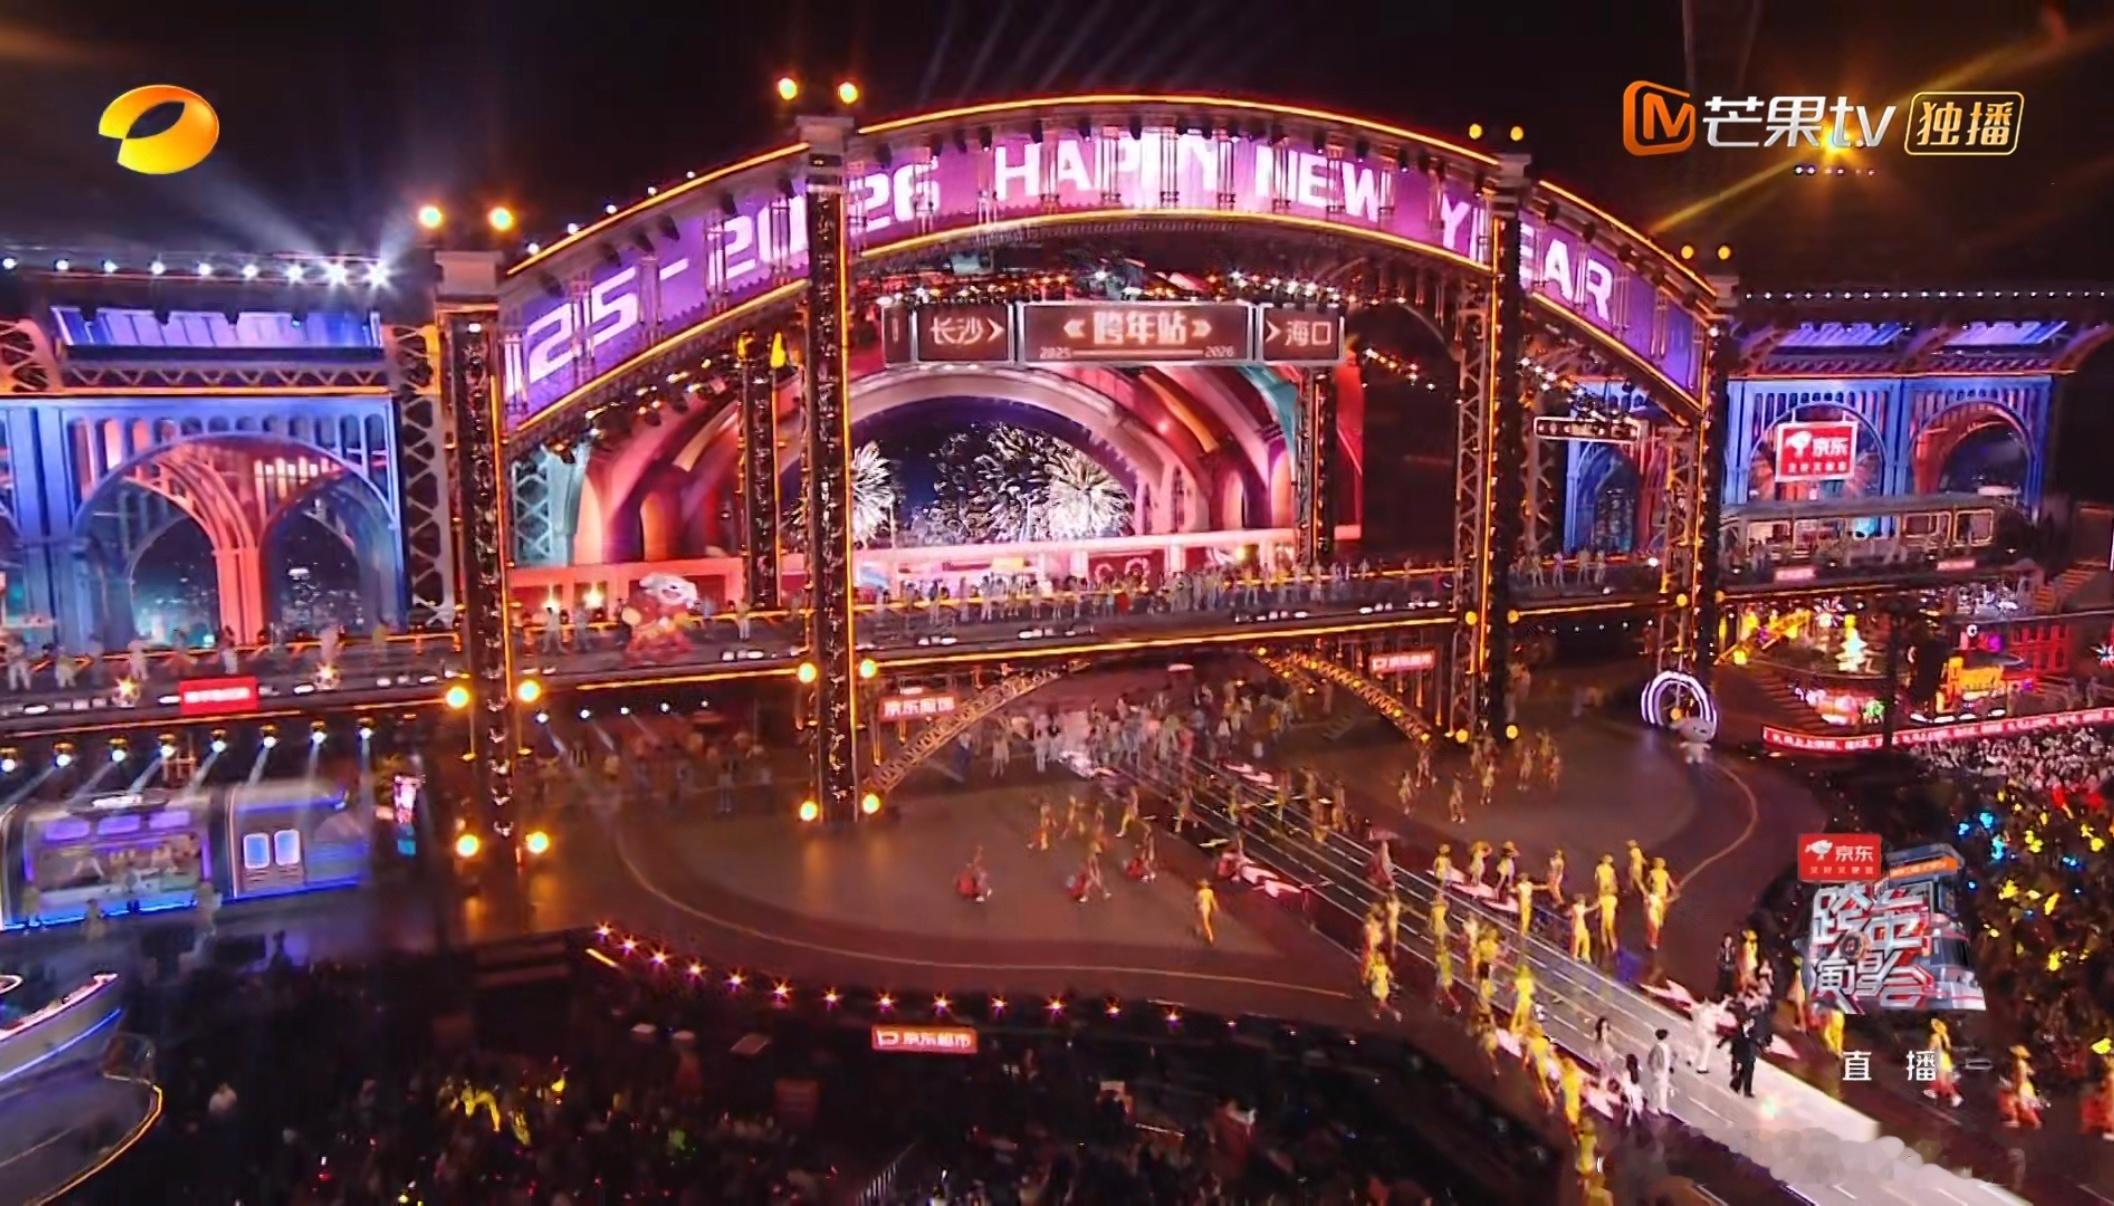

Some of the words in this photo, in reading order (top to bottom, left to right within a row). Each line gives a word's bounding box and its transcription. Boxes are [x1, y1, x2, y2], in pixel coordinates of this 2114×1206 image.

[930, 316, 984, 346] 长沙
[1092, 310, 1188, 346] 跨年站
[1284, 320, 1332, 347] 海口
[1812, 437, 1850, 457] 京东
